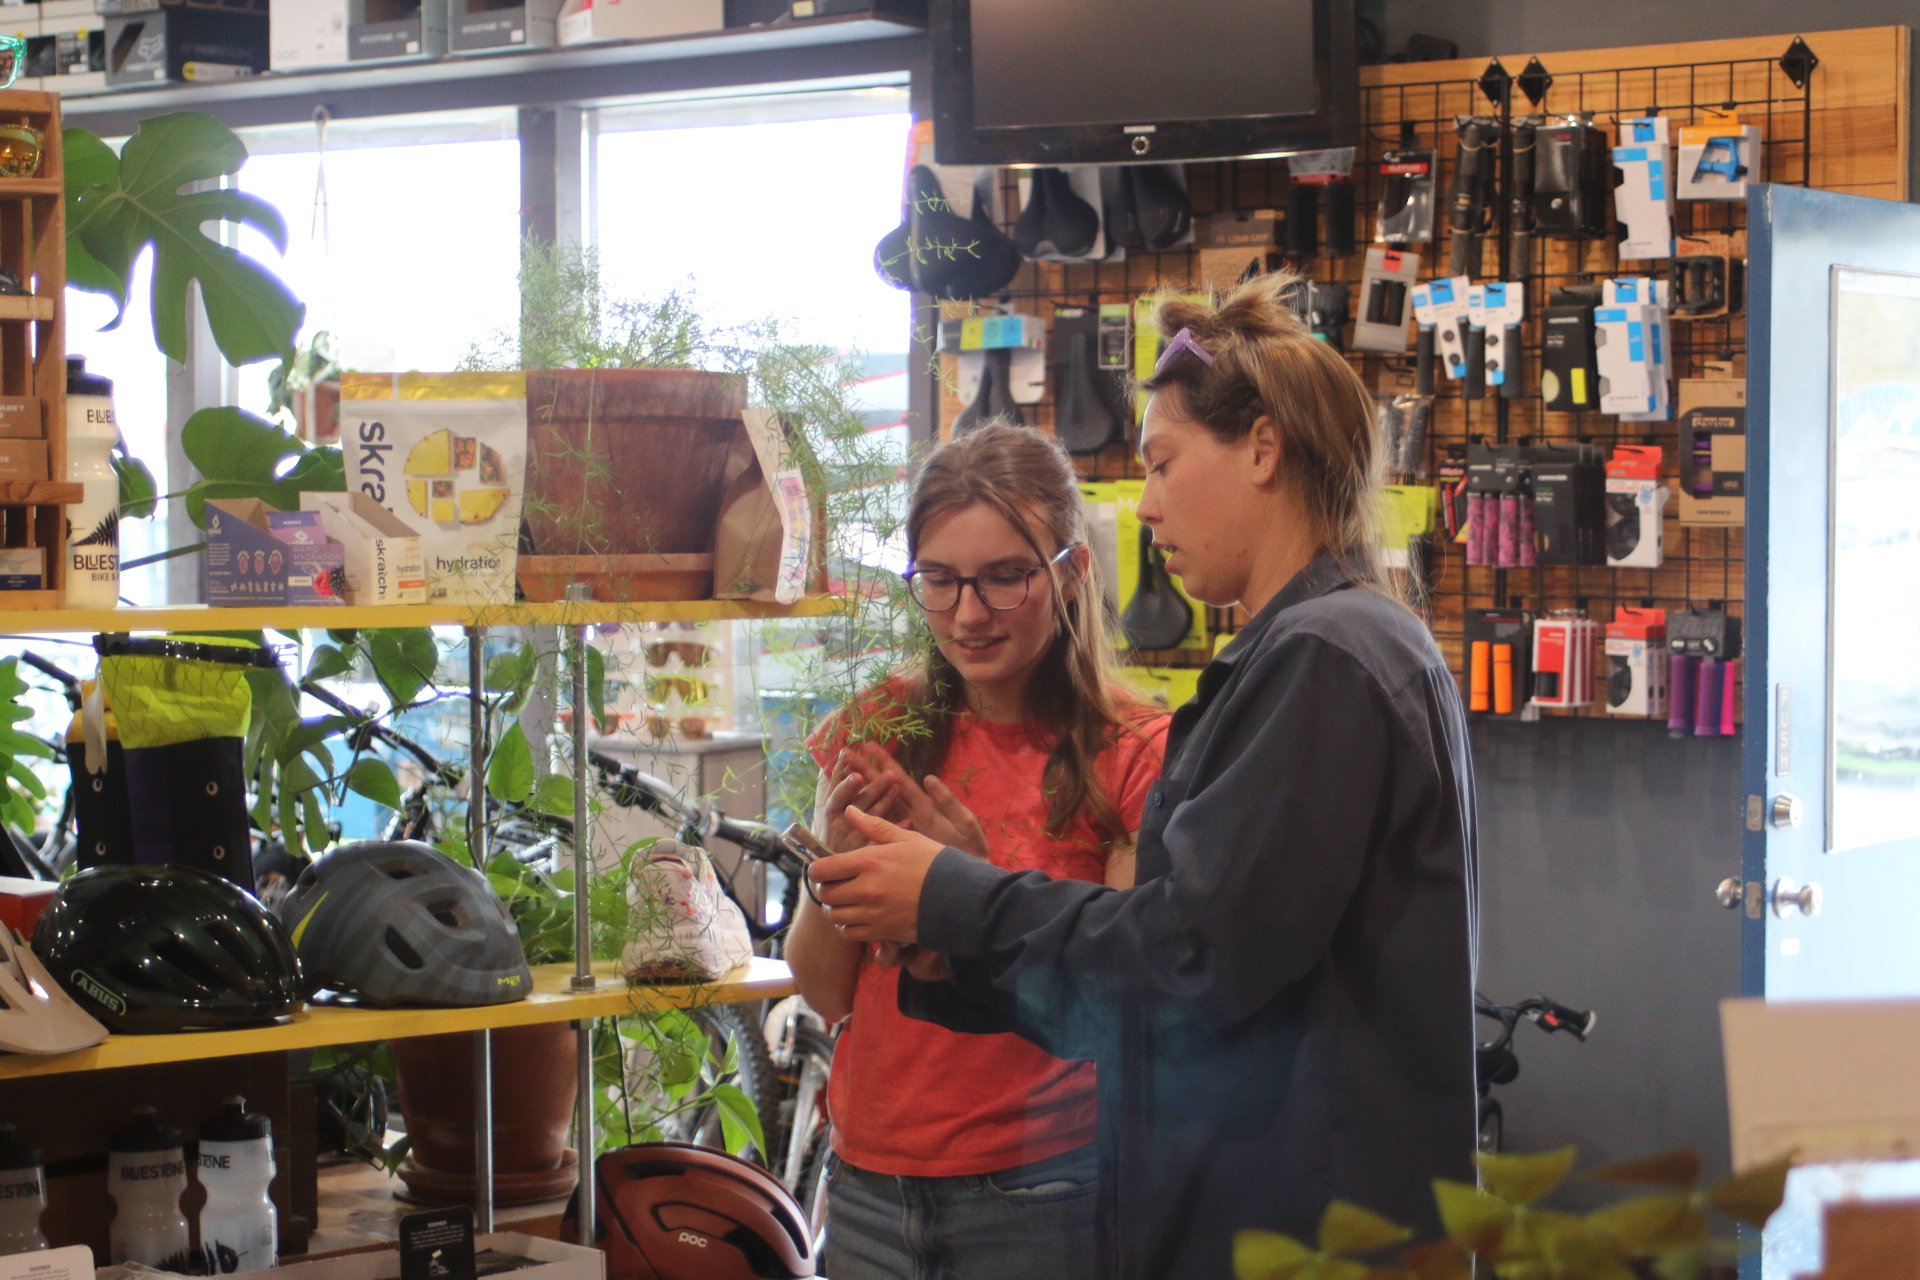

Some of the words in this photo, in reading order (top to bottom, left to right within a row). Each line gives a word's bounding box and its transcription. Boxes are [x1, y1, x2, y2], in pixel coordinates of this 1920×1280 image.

[359, 421, 393, 514] skra
[91, 573, 110, 582] BIKE
[375, 539, 388, 596] skratch
[1780, 687, 1789, 771] PUSH
[76, 976, 119, 1012] ABUS
[496, 975, 520, 986] MET
[120, 1162, 184, 1181] BLUESTONE
[678, 1232, 708, 1248] poc
